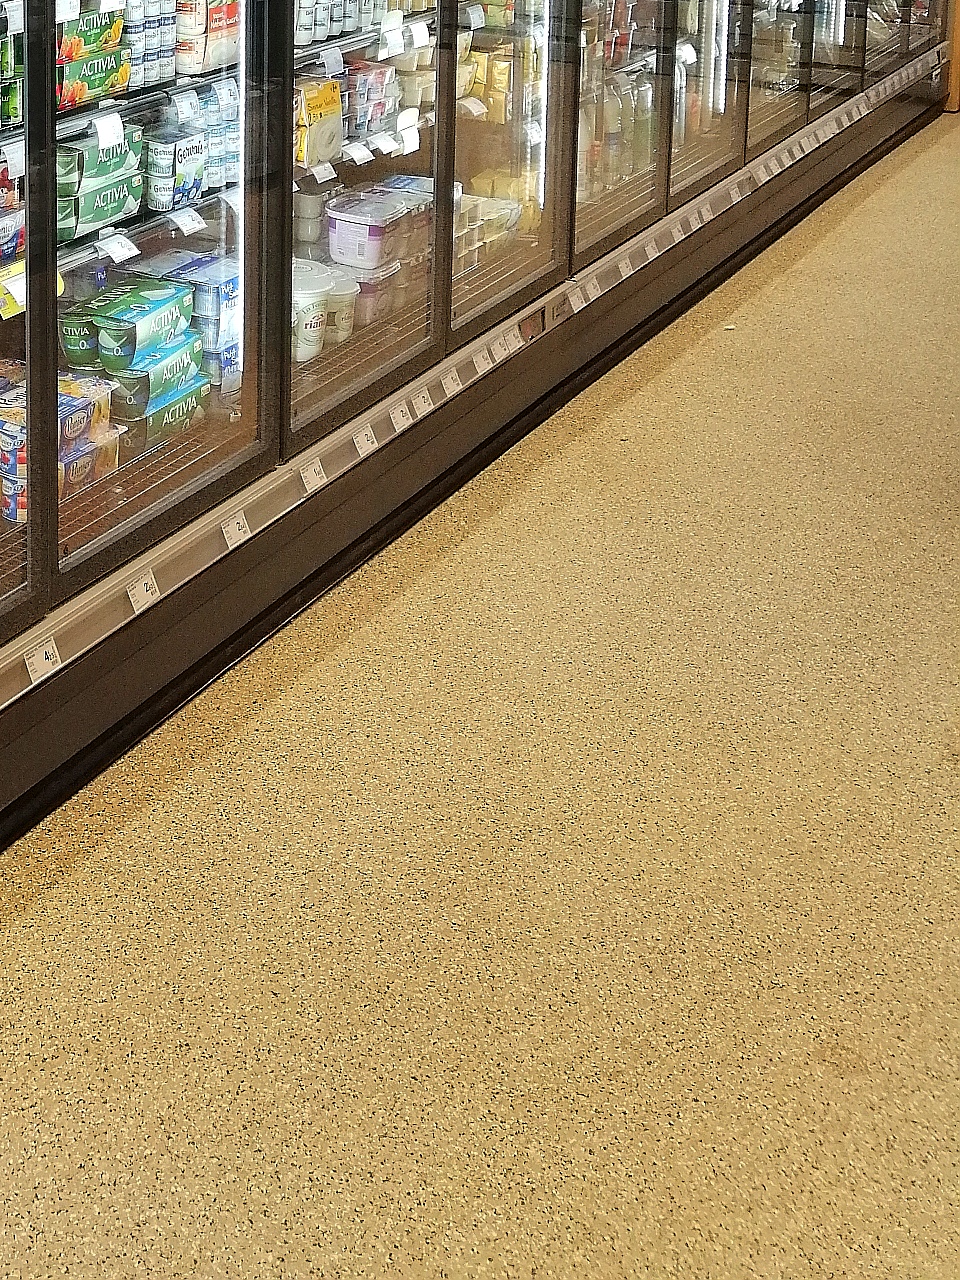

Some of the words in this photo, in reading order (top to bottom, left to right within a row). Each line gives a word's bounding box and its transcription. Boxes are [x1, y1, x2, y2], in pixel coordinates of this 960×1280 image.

[77, 13, 111, 33] ACTIVIA
[80, 55, 117, 77] ACTIVIA
[93, 186, 129, 209] ACTIVIA
[149, 304, 180, 334] ACTIVIA
[161, 354, 192, 382] ACTIVIA
[161, 398, 197, 428] ACTIVIA
